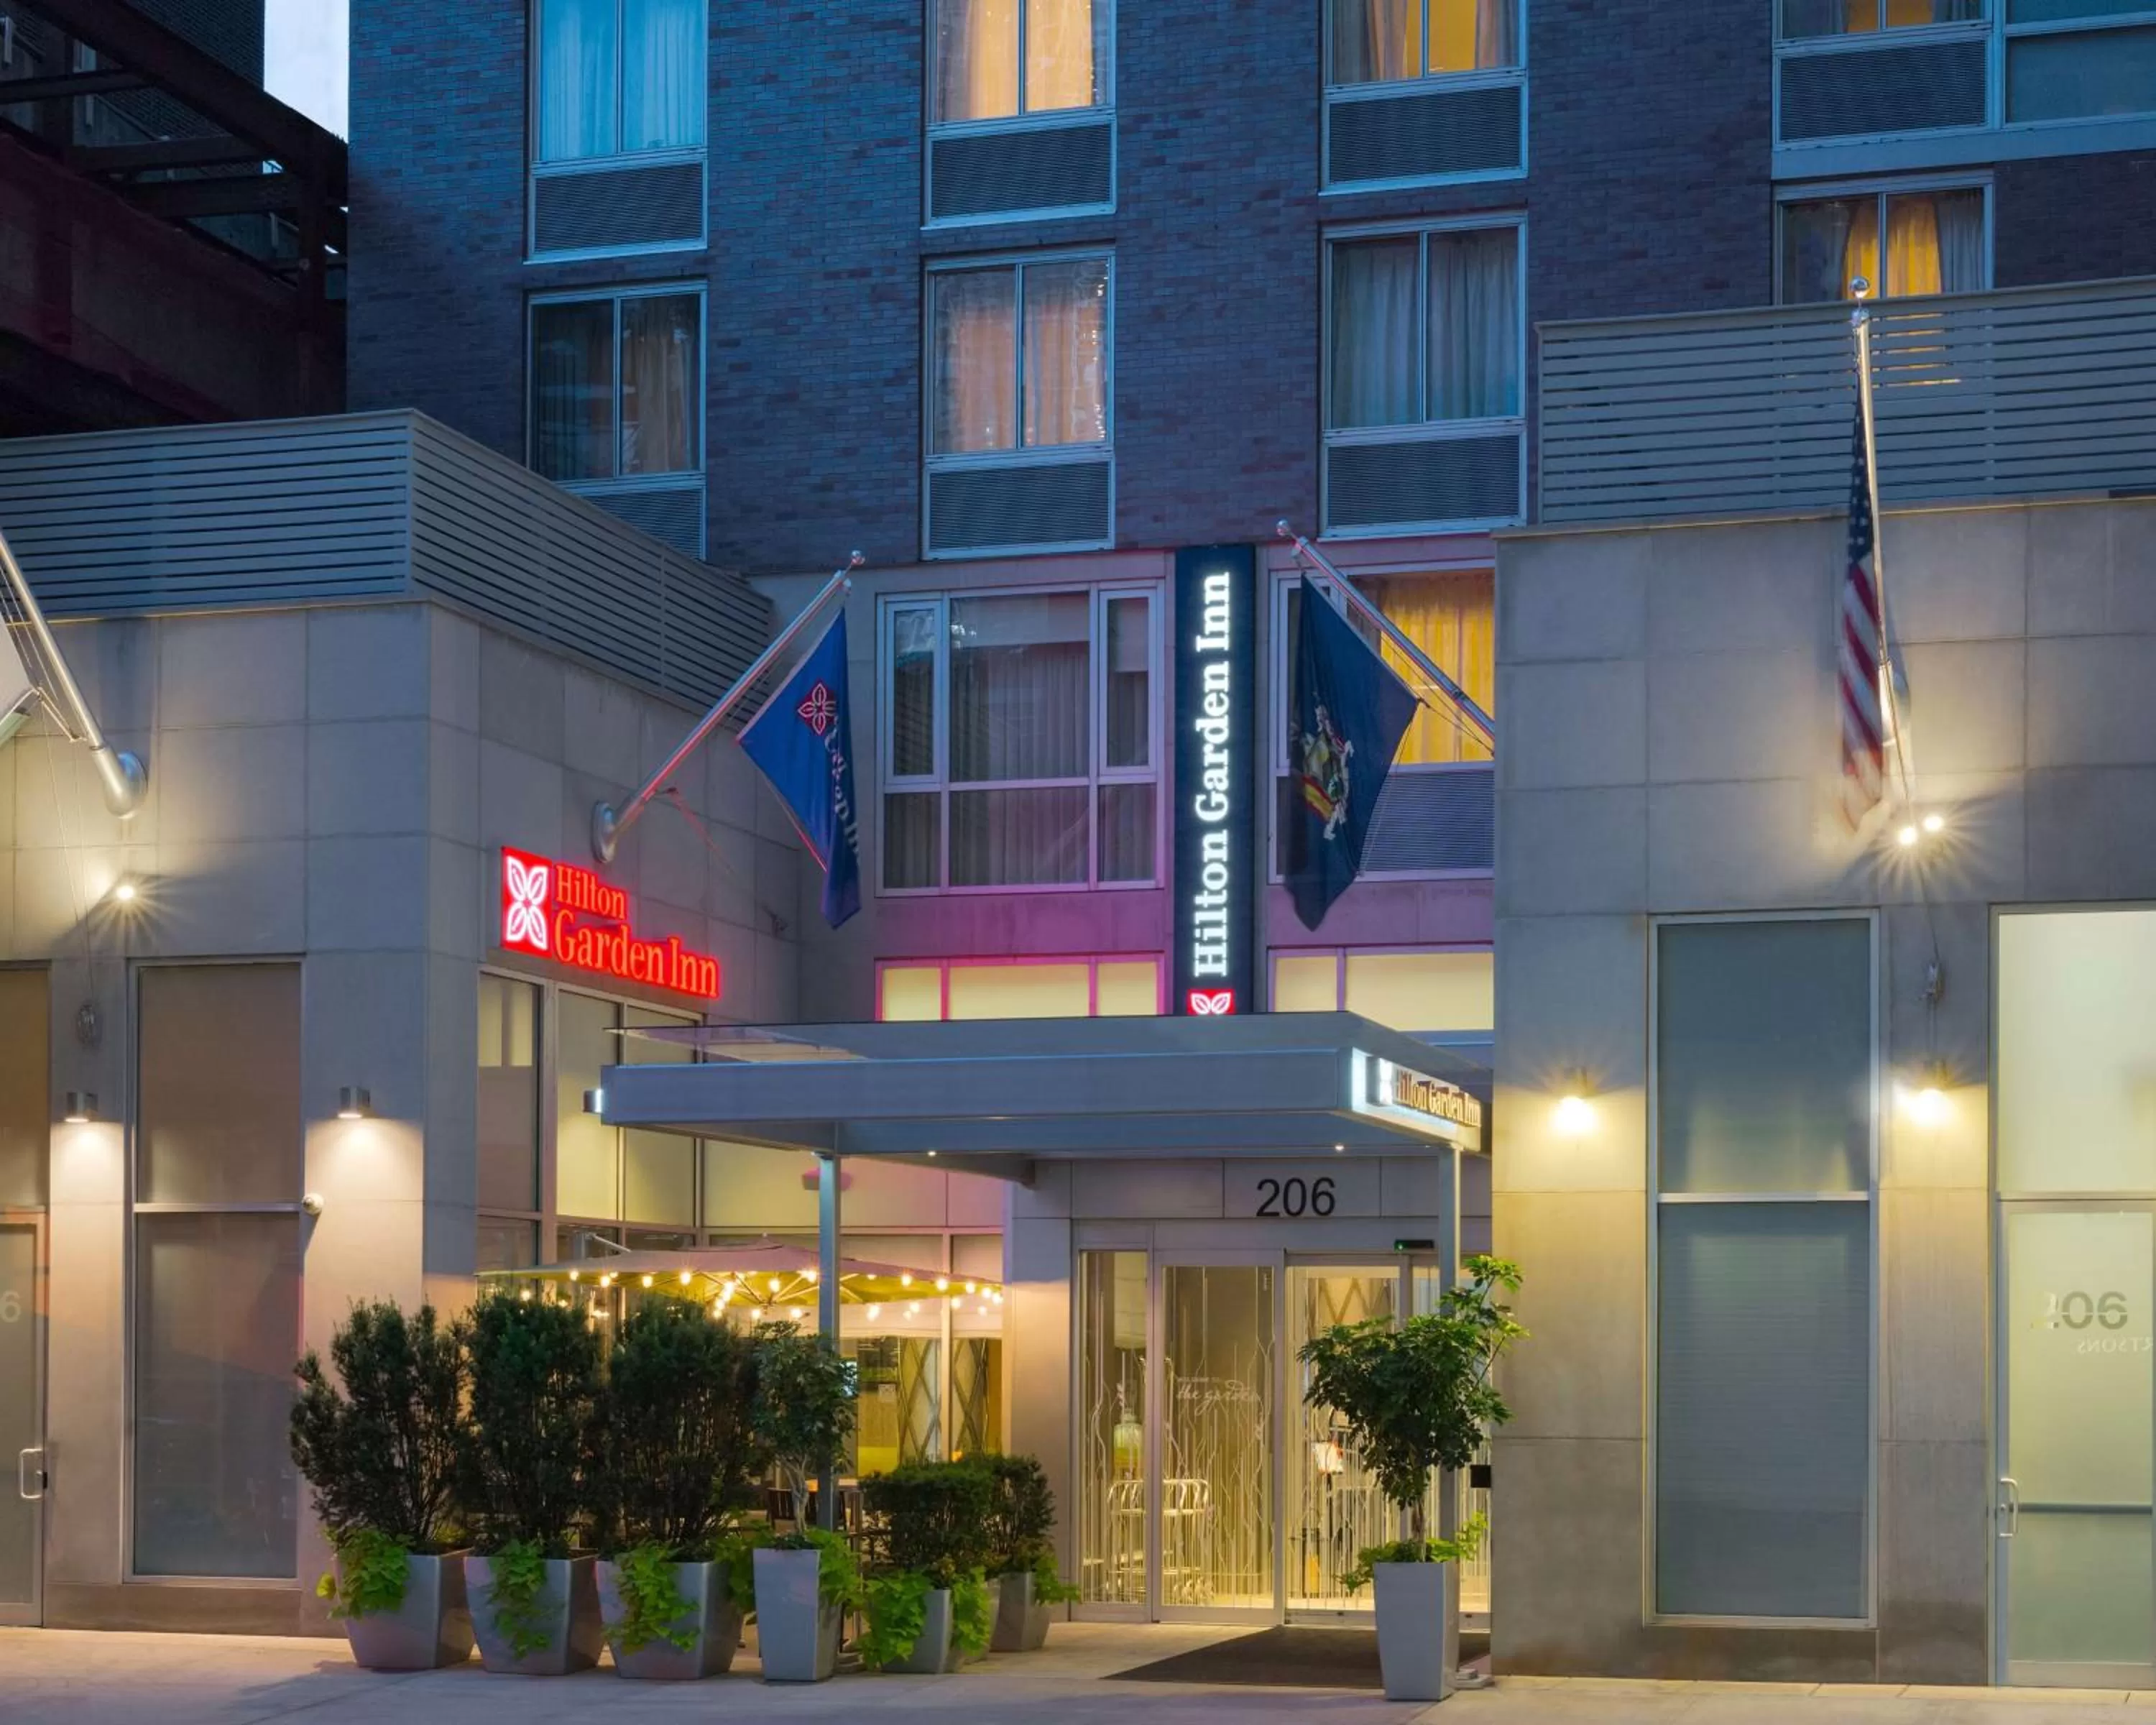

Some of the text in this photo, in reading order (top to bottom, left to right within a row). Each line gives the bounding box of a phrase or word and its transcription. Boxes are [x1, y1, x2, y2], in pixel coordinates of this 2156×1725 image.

[1194, 571, 1230, 978] Hilton Garden Inn
[554, 864, 627, 920] Hilton
[554, 909, 718, 998] Garden Inn
[1429, 1082, 1463, 1122] Garden
[1464, 1092, 1481, 1128] Inn
[1256, 1177, 1335, 1216] 206
